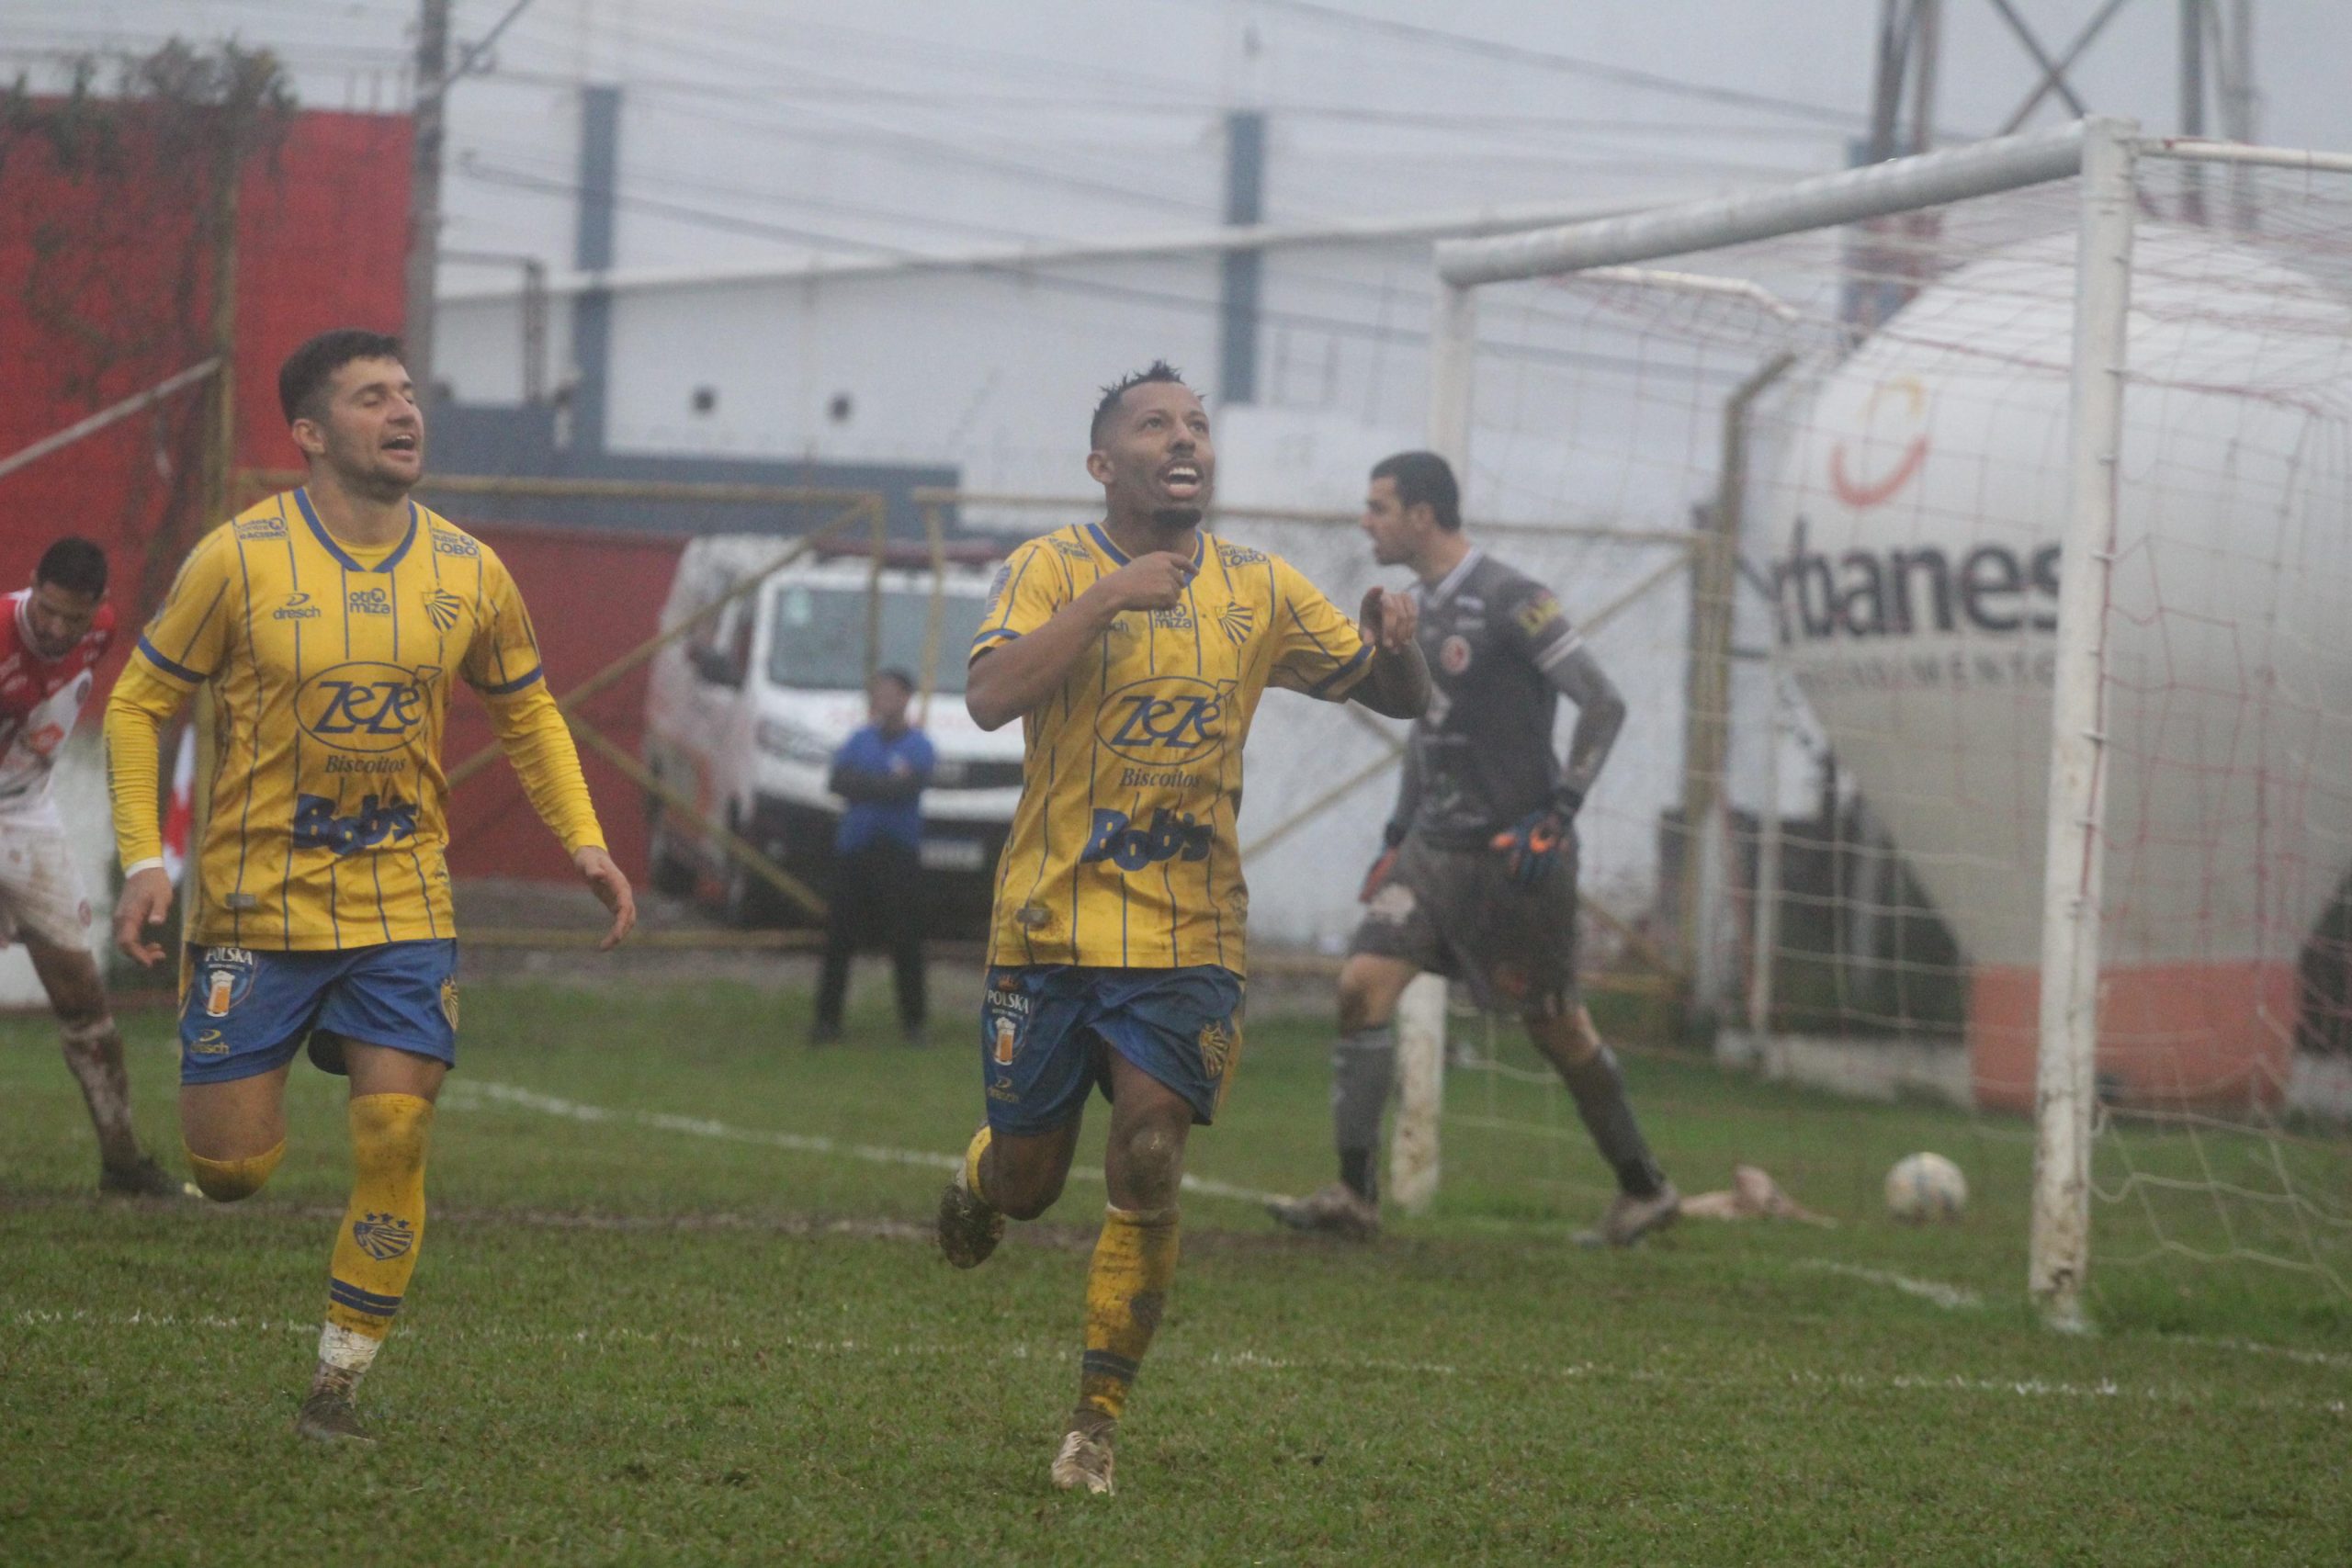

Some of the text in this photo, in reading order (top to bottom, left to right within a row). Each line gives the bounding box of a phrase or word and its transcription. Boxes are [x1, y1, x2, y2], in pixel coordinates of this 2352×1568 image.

[435, 541, 478, 557] LOBO
[273, 605, 322, 620] dresch
[324, 754, 406, 774] Biscoitos
[1119, 767, 1203, 788] Biscoitos
[205, 946, 253, 965] POLSKA
[988, 989, 1029, 1014] POLSKA
